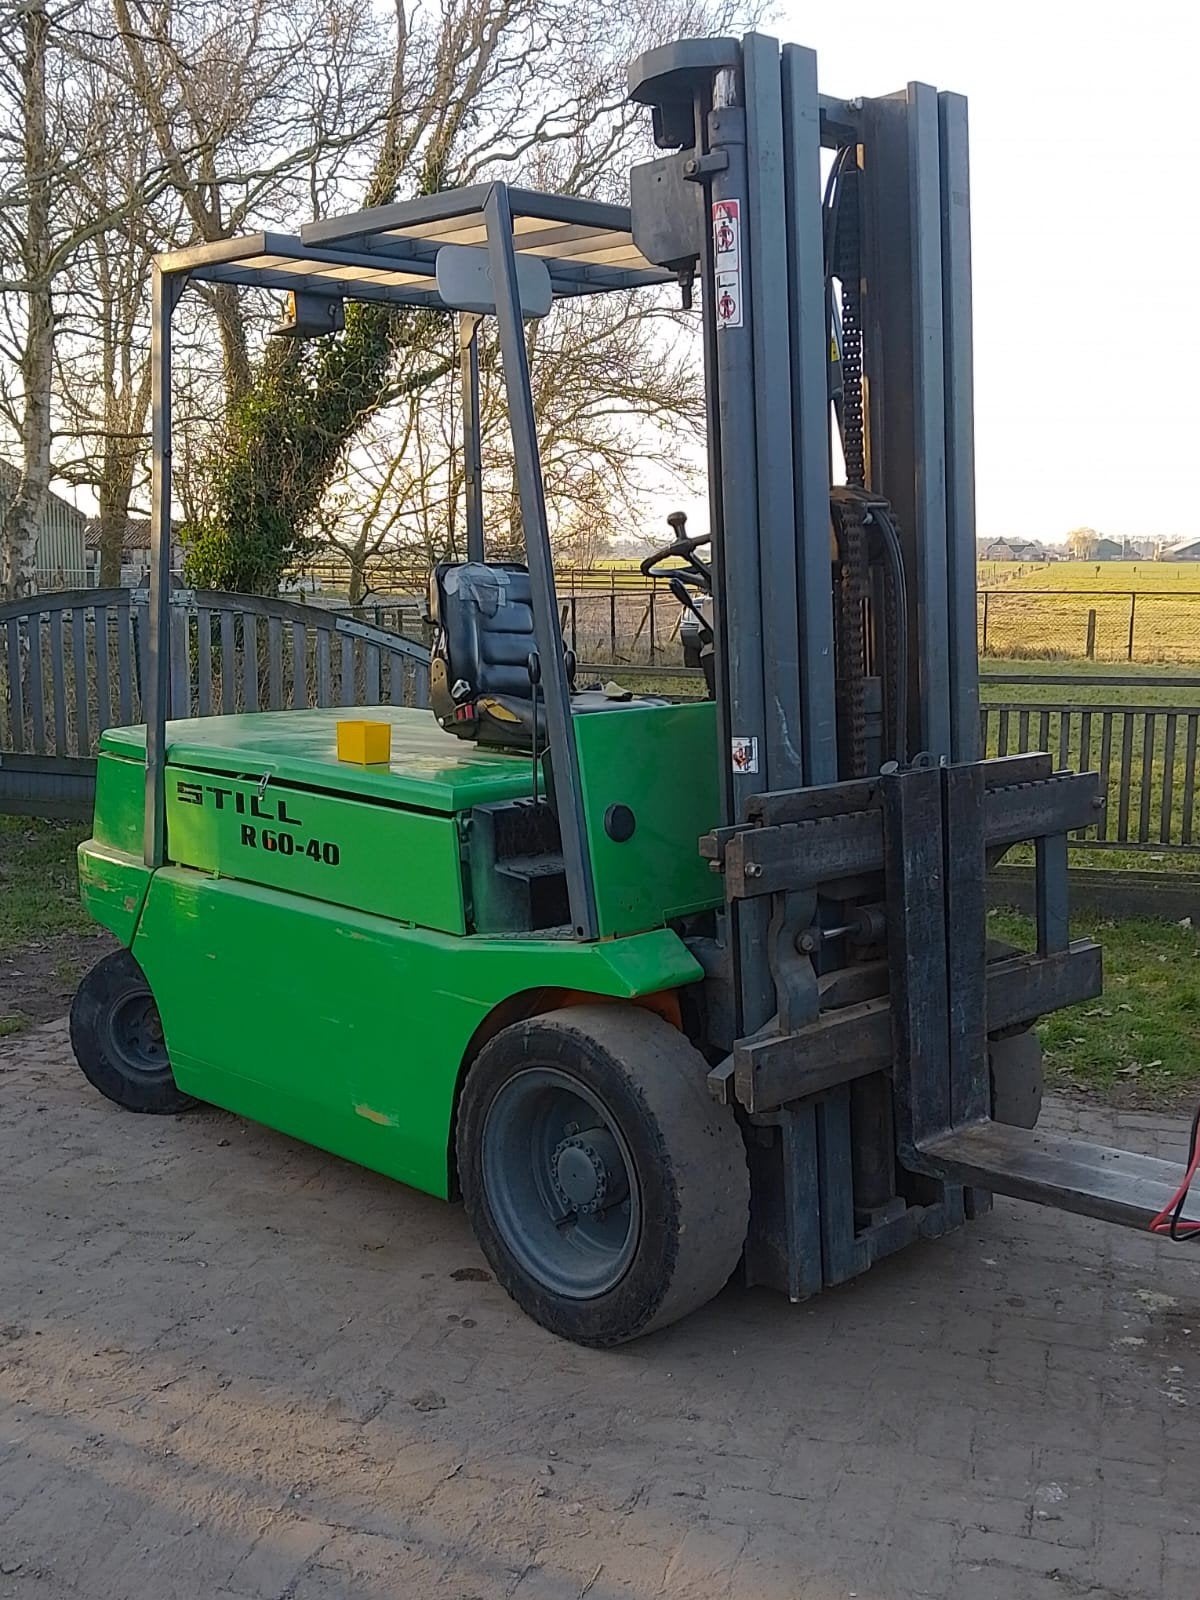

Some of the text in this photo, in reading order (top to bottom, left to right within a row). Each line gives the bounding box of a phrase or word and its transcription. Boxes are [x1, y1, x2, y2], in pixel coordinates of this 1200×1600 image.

[177, 781, 302, 826] STILL
[241, 824, 340, 866] R 60-40
